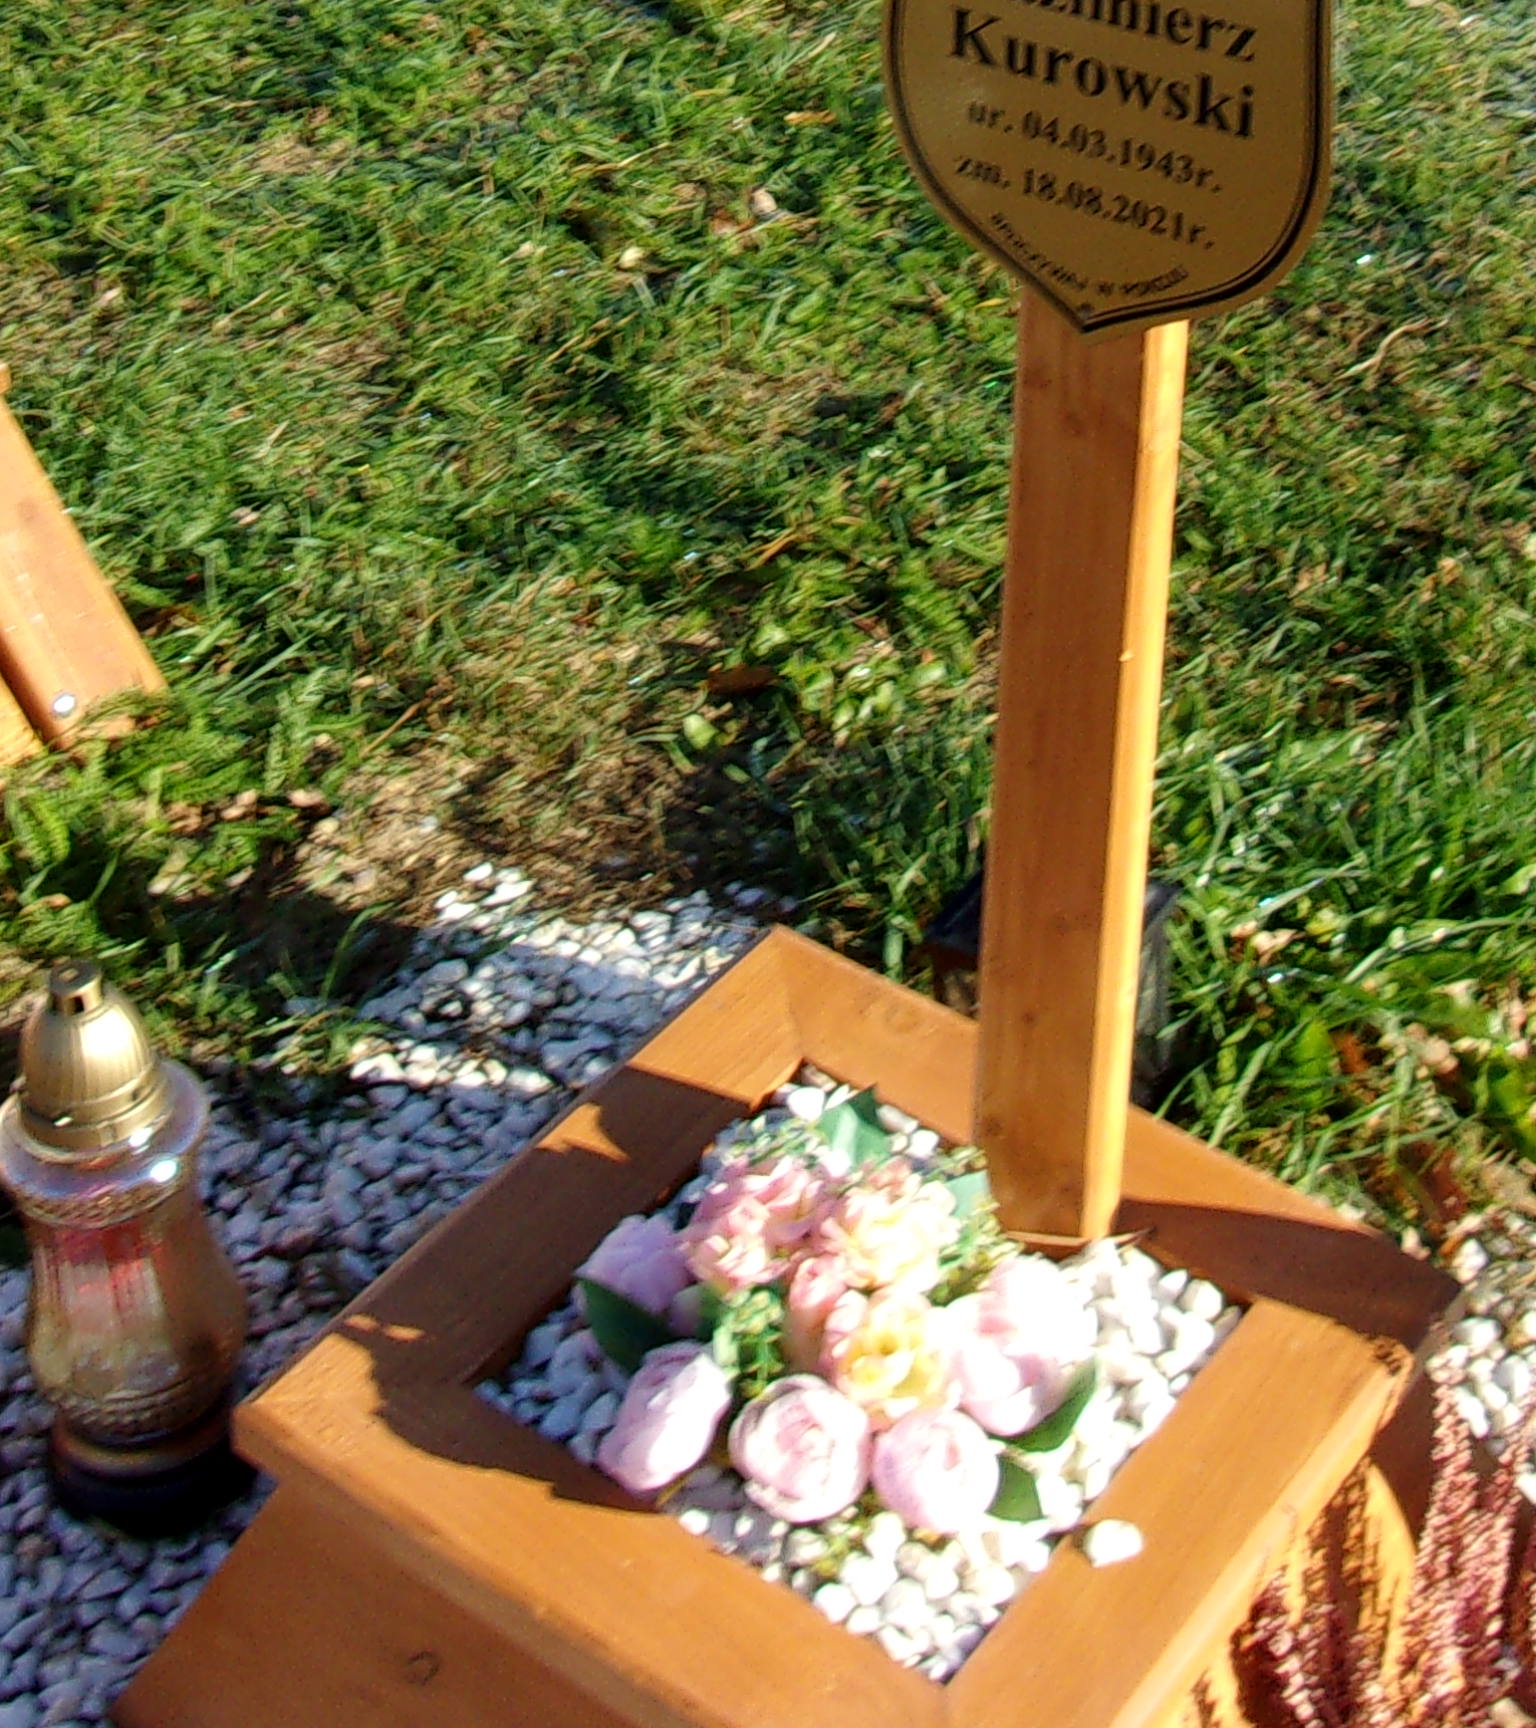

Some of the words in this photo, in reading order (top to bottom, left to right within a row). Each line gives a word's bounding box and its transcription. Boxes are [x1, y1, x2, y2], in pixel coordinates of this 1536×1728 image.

[949, 6, 1255, 138] Kurowski
[955, 155, 1011, 190] zm.
[968, 101, 1014, 133] ur.
[1022, 110, 1222, 194] 04.03.1943r.
